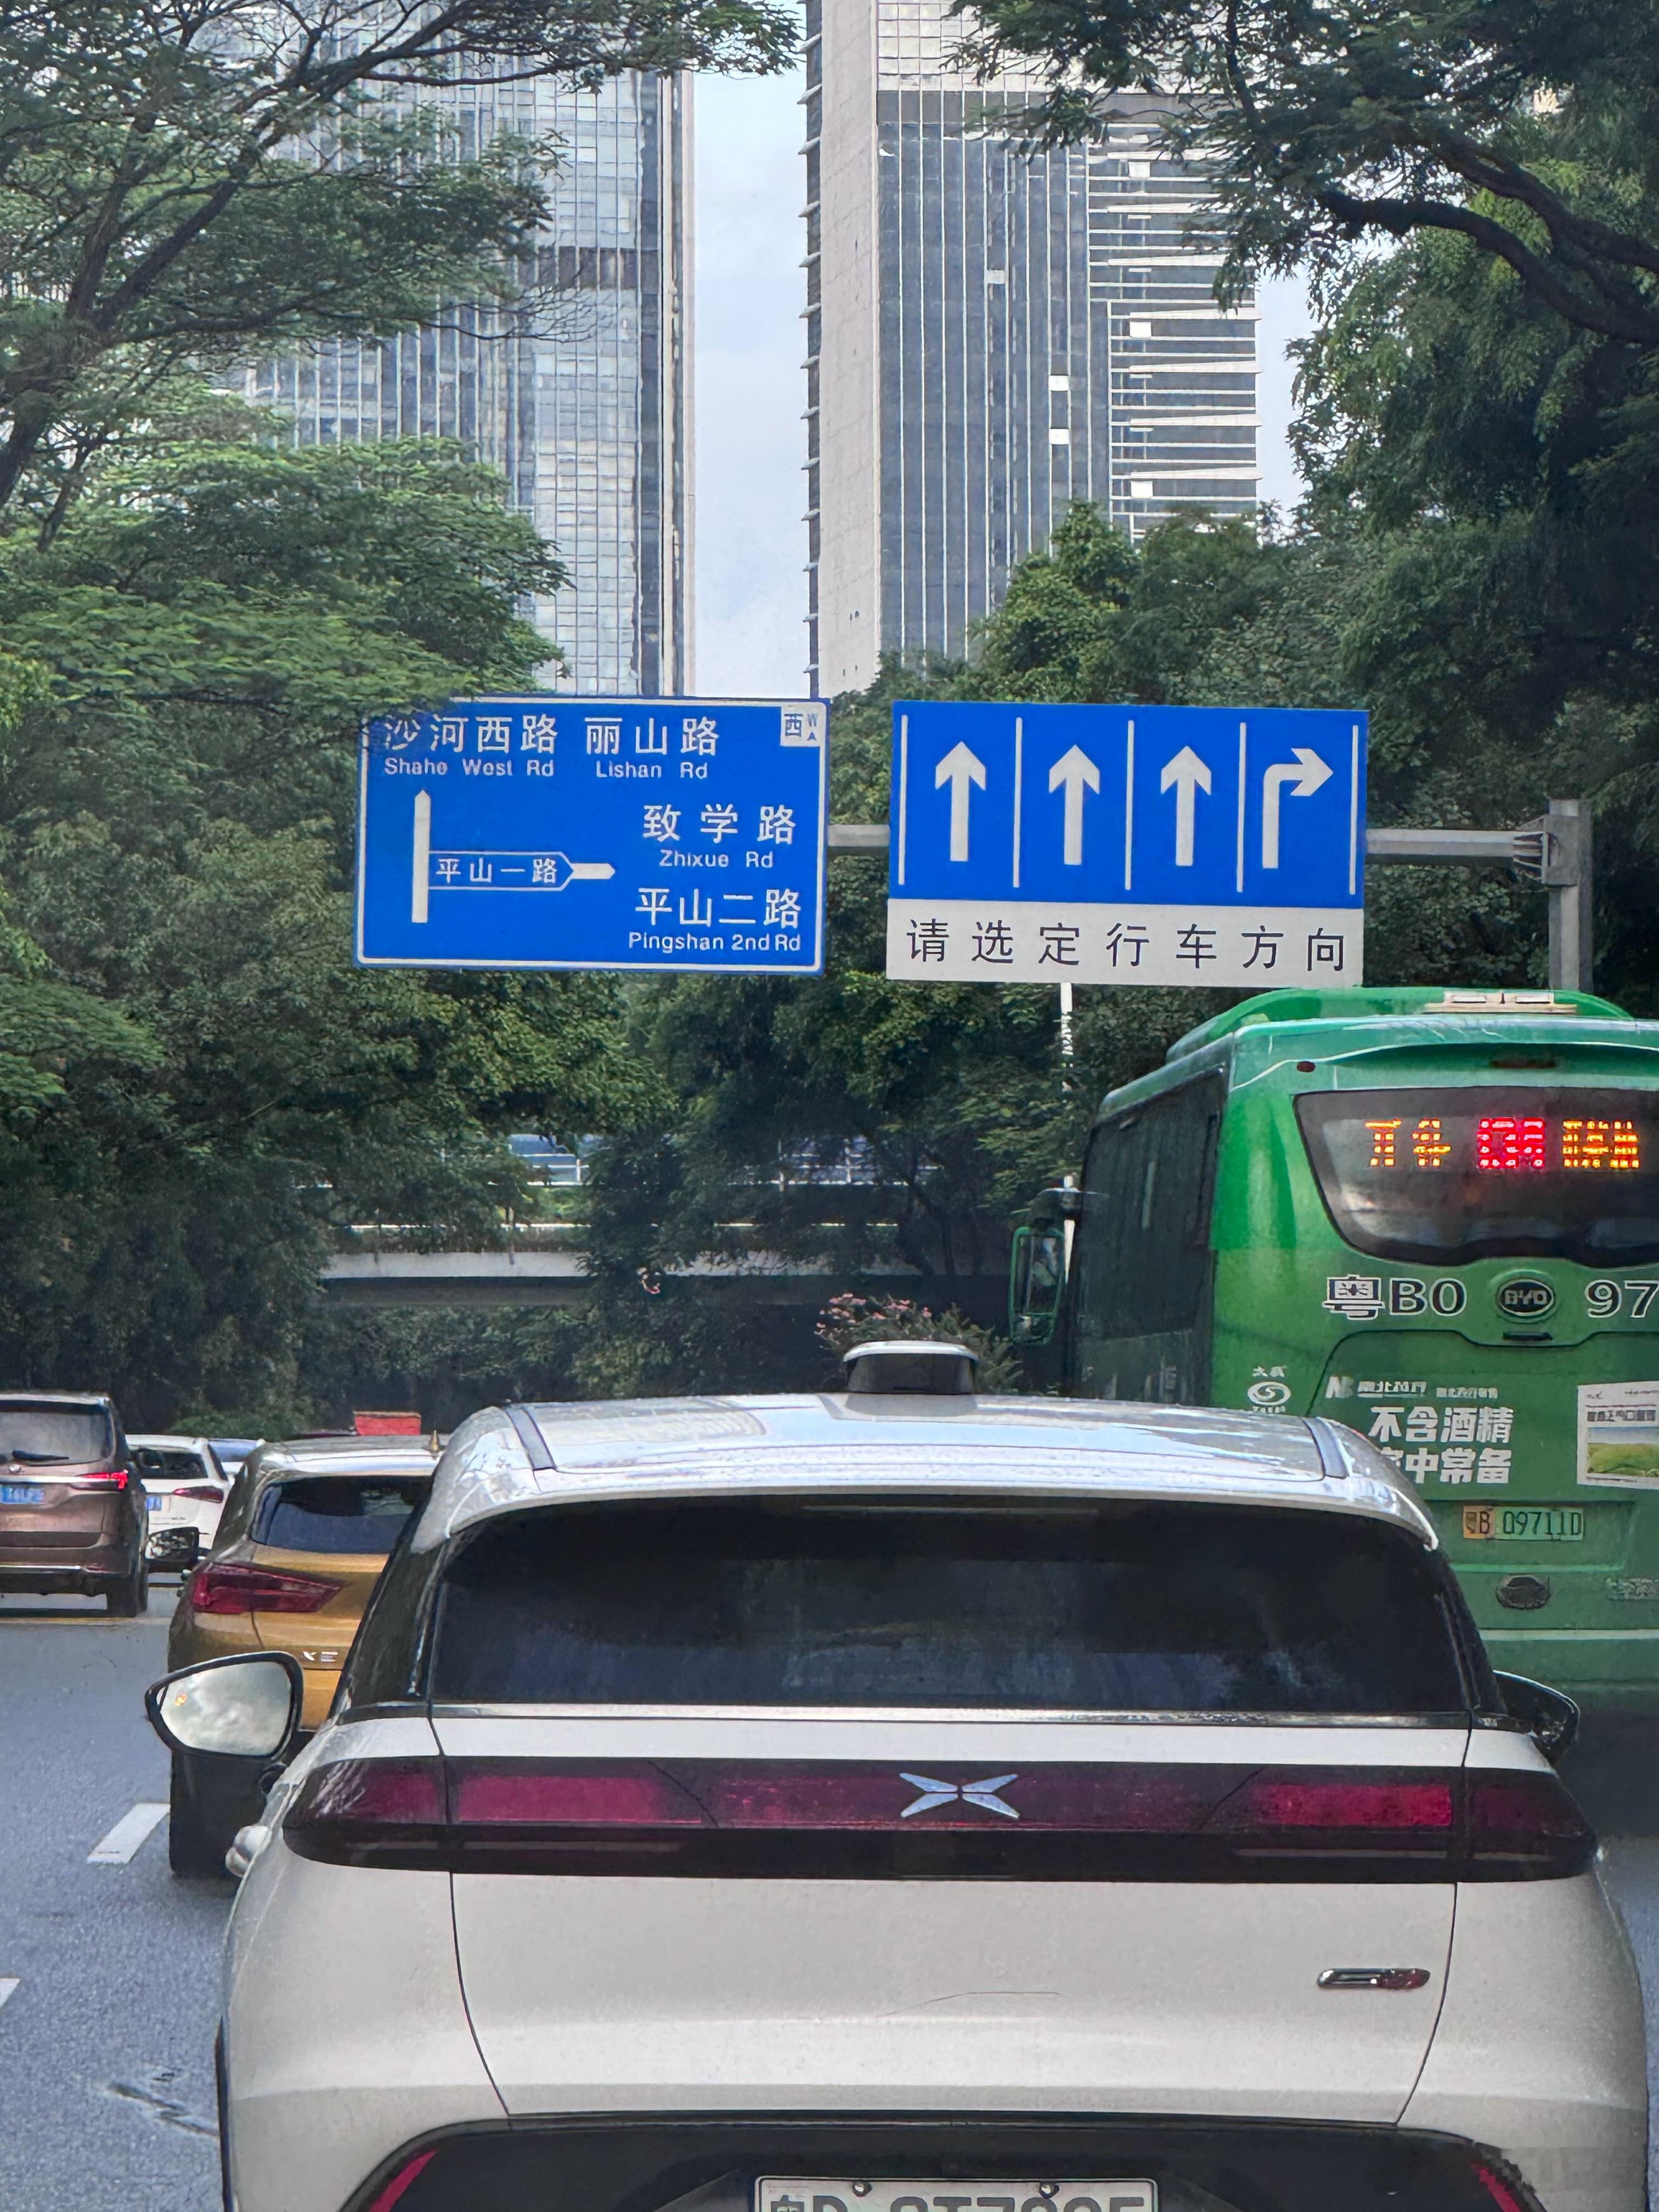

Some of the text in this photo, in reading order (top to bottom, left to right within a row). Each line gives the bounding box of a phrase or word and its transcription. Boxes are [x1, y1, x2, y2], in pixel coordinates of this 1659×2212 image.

[784, 714, 803, 737] 西
[807, 713, 818, 727] W
[385, 713, 719, 756] 沙河西路 丽山路
[385, 758, 554, 777] Shahe West Rd
[596, 760, 708, 780] Lishan Rd
[643, 804, 795, 845] 致学路
[659, 849, 774, 868] Zhixue Rd
[435, 857, 557, 884] 平山一路
[635, 888, 801, 929] 平山二路
[629, 932, 800, 953] Pingshan 2nd Rd
[906, 918, 1345, 972] 请选定行车方向
[1504, 1289, 1548, 1305] BYD
[1368, 1406, 1514, 1443] 不含酒精
